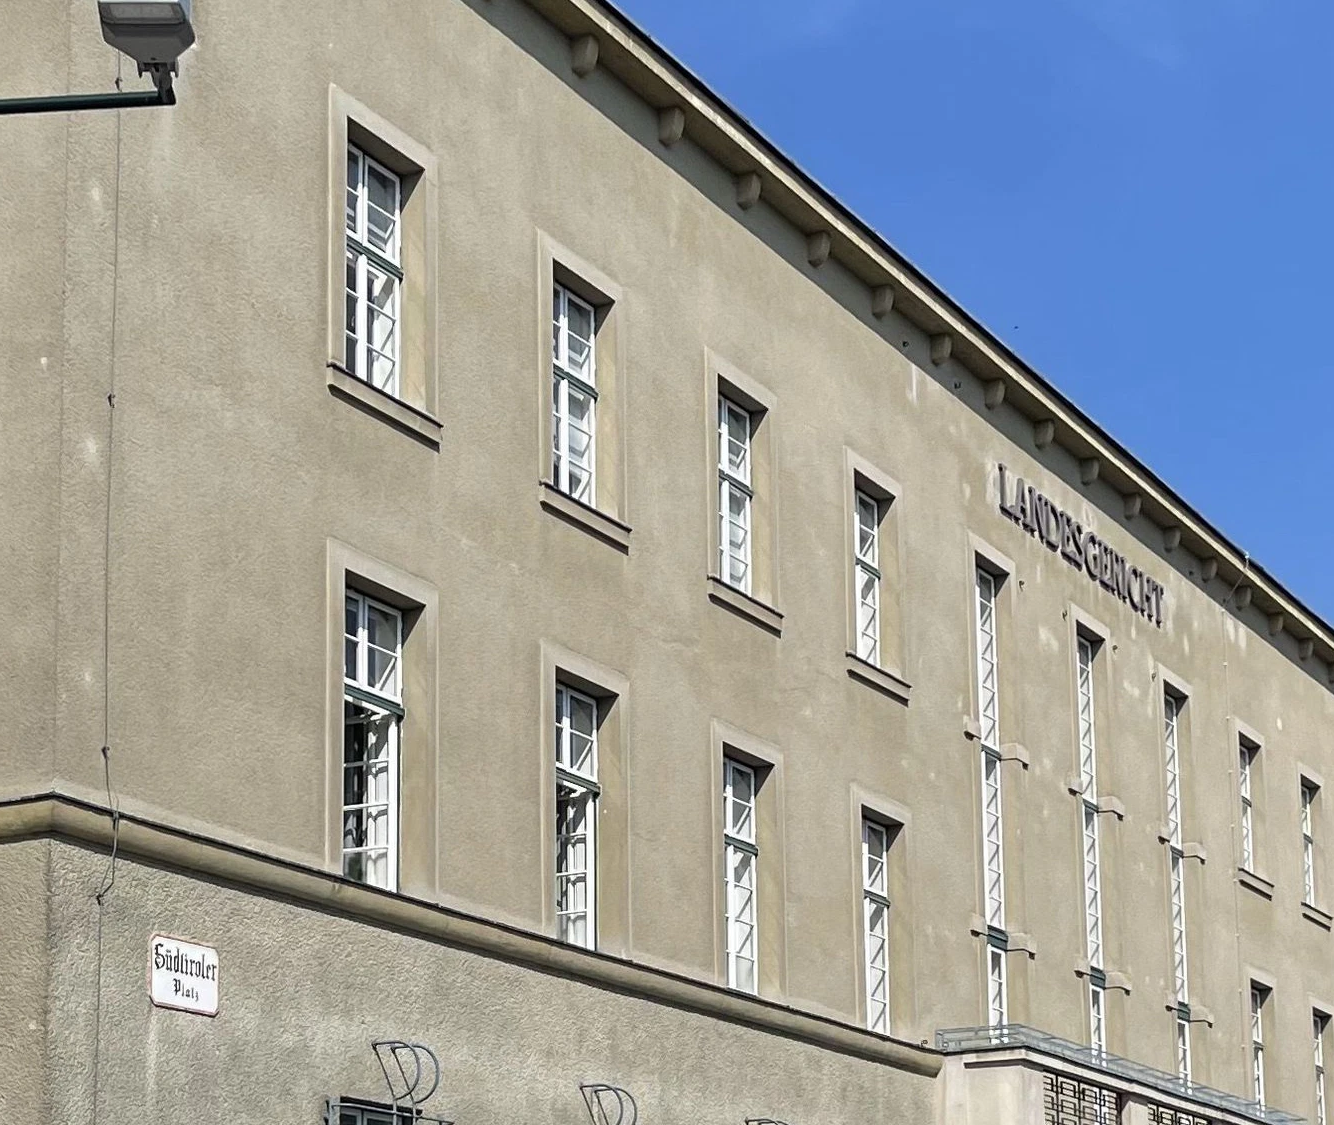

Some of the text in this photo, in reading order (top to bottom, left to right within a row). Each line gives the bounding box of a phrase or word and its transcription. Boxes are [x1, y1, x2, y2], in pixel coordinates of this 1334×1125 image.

[998, 463, 1164, 628] LANDESGERICHT
[154, 943, 217, 981] Südtiroler
[173, 978, 199, 1002] Platz
